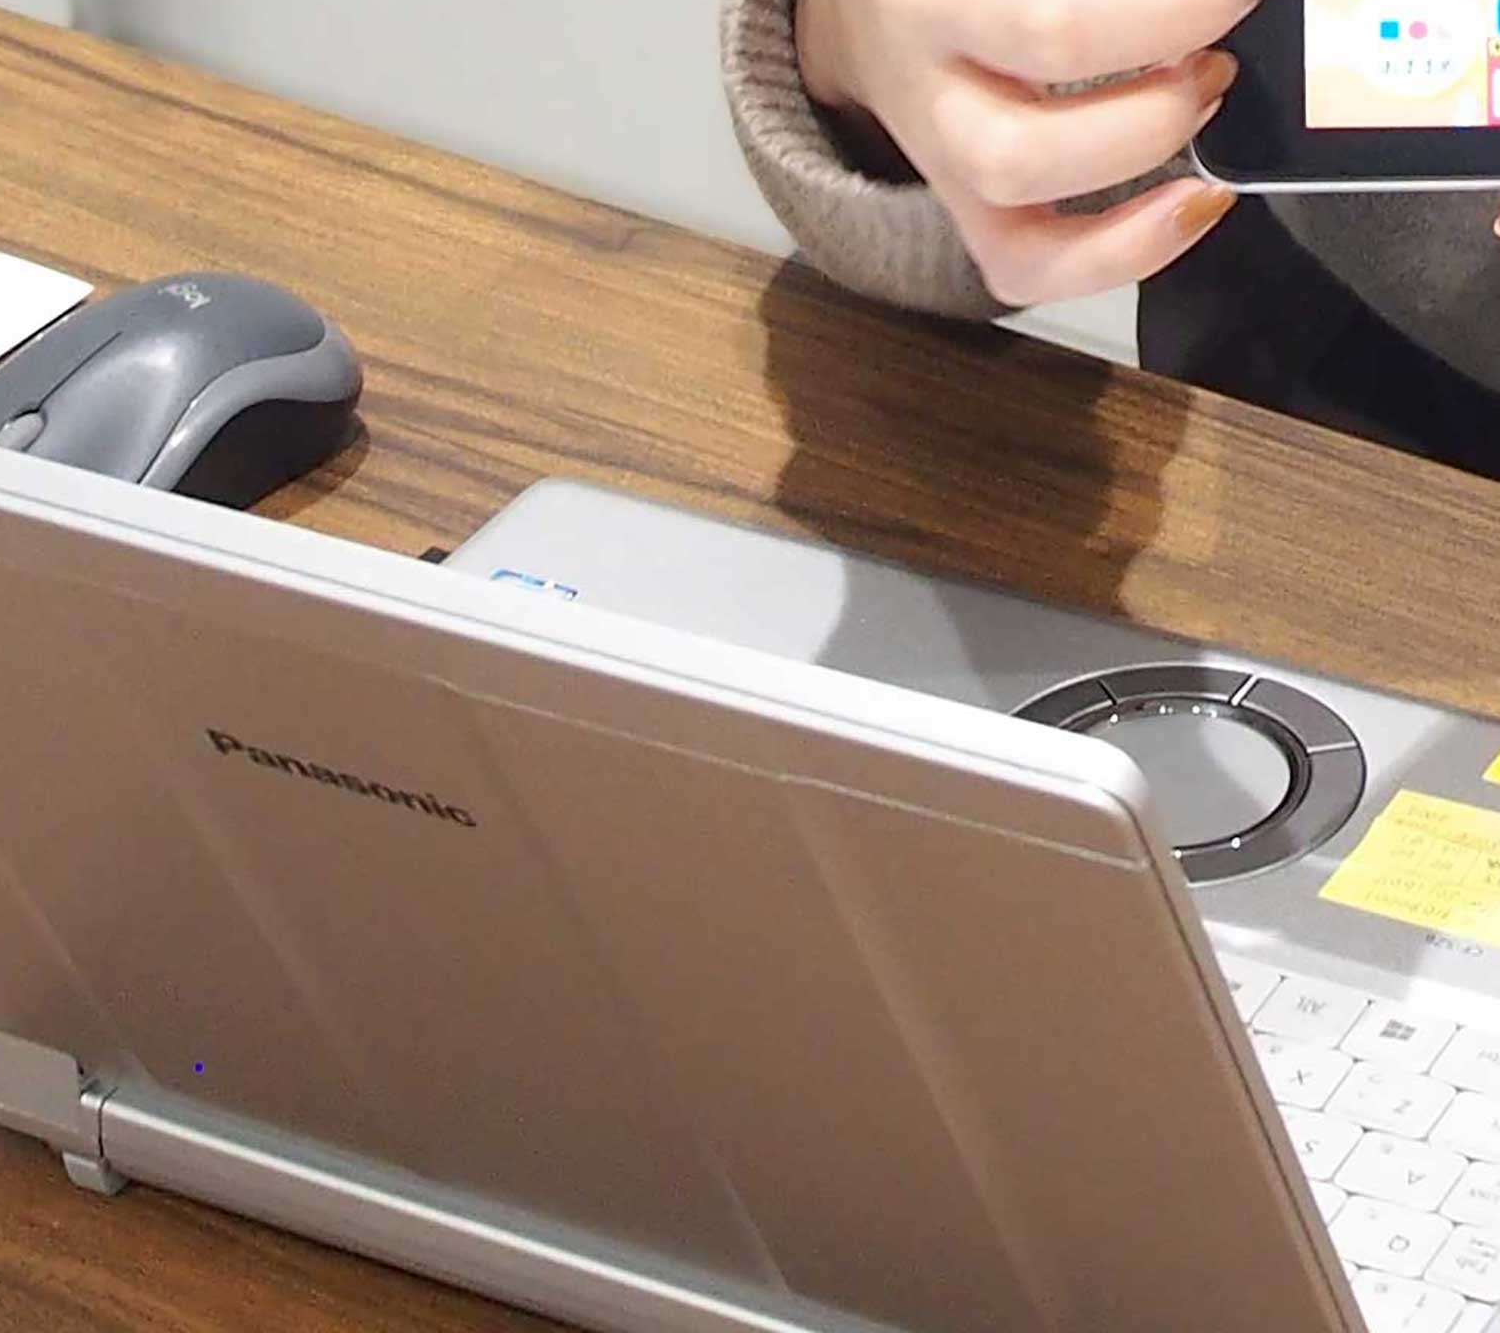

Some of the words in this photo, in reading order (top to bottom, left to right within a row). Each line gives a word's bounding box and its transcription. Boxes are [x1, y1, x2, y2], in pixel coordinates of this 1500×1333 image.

[205, 727, 477, 827] Panasonic
[1404, 1168, 1427, 1187] A
[1387, 1234, 1410, 1253] Q
